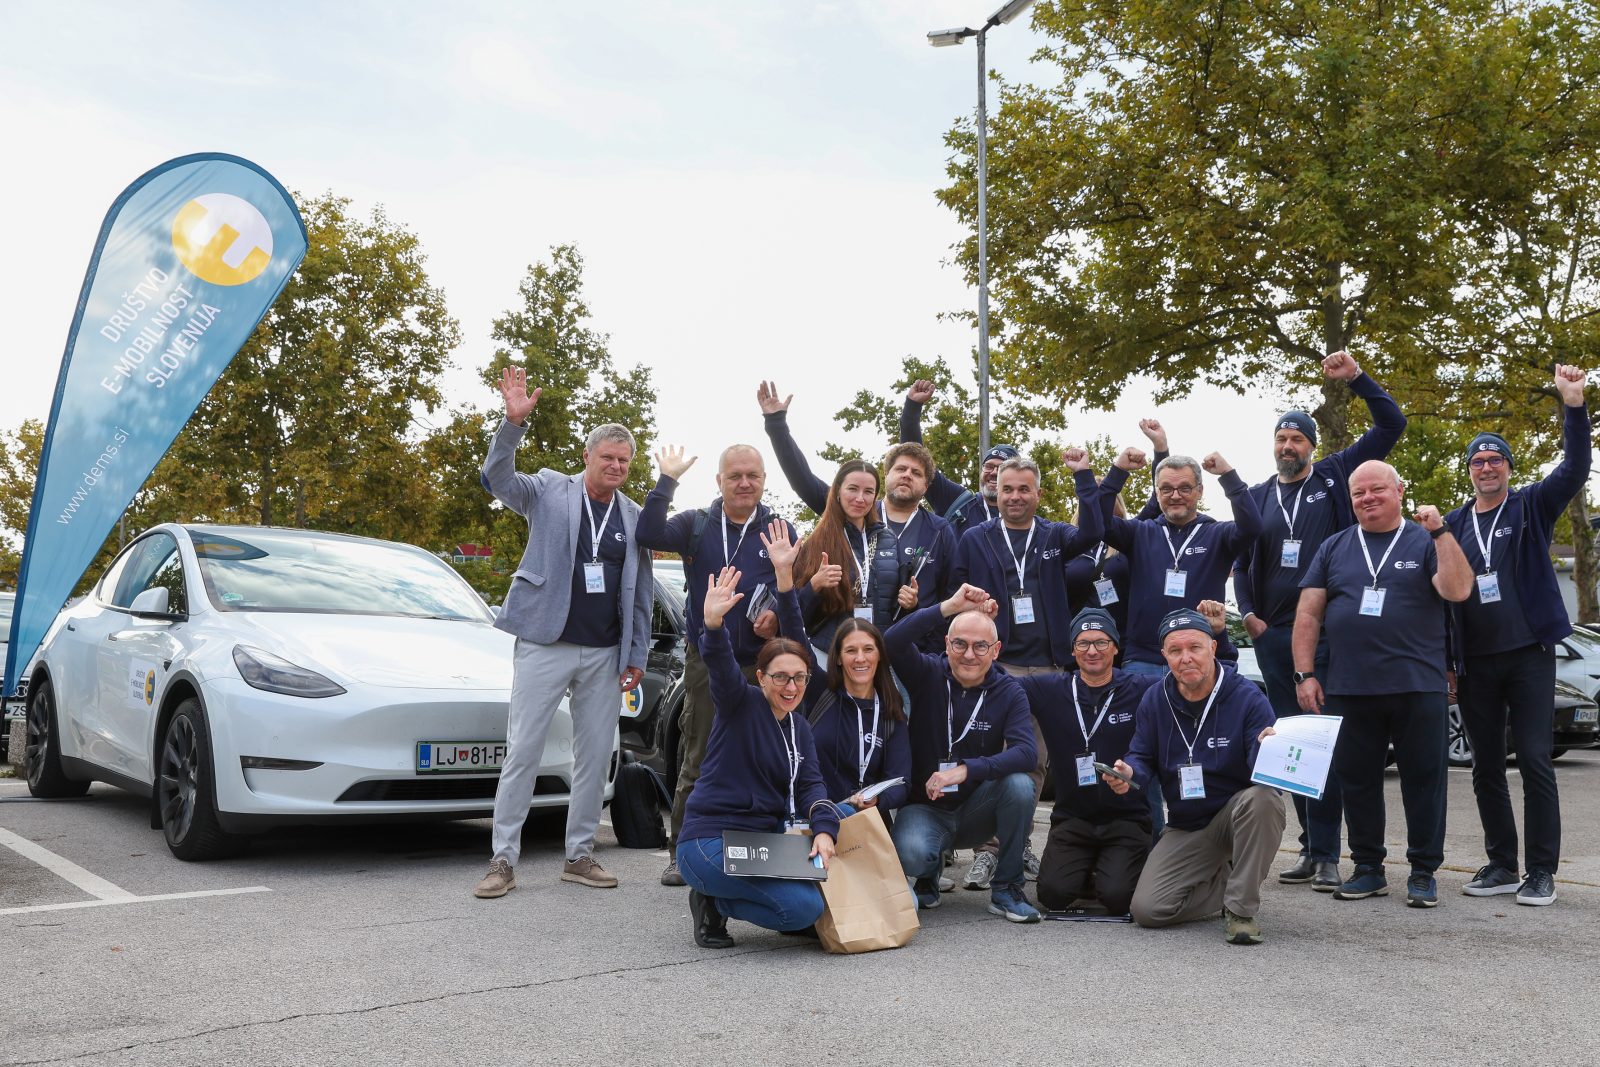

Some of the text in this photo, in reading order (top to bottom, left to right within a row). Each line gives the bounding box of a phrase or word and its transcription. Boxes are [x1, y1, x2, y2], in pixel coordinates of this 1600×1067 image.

[100, 267, 169, 343] DRUŠTVO
[100, 282, 194, 395] E-MOBILNOST
[146, 303, 221, 388] SLOVENIJA
[56, 425, 130, 524] www.dems.si
